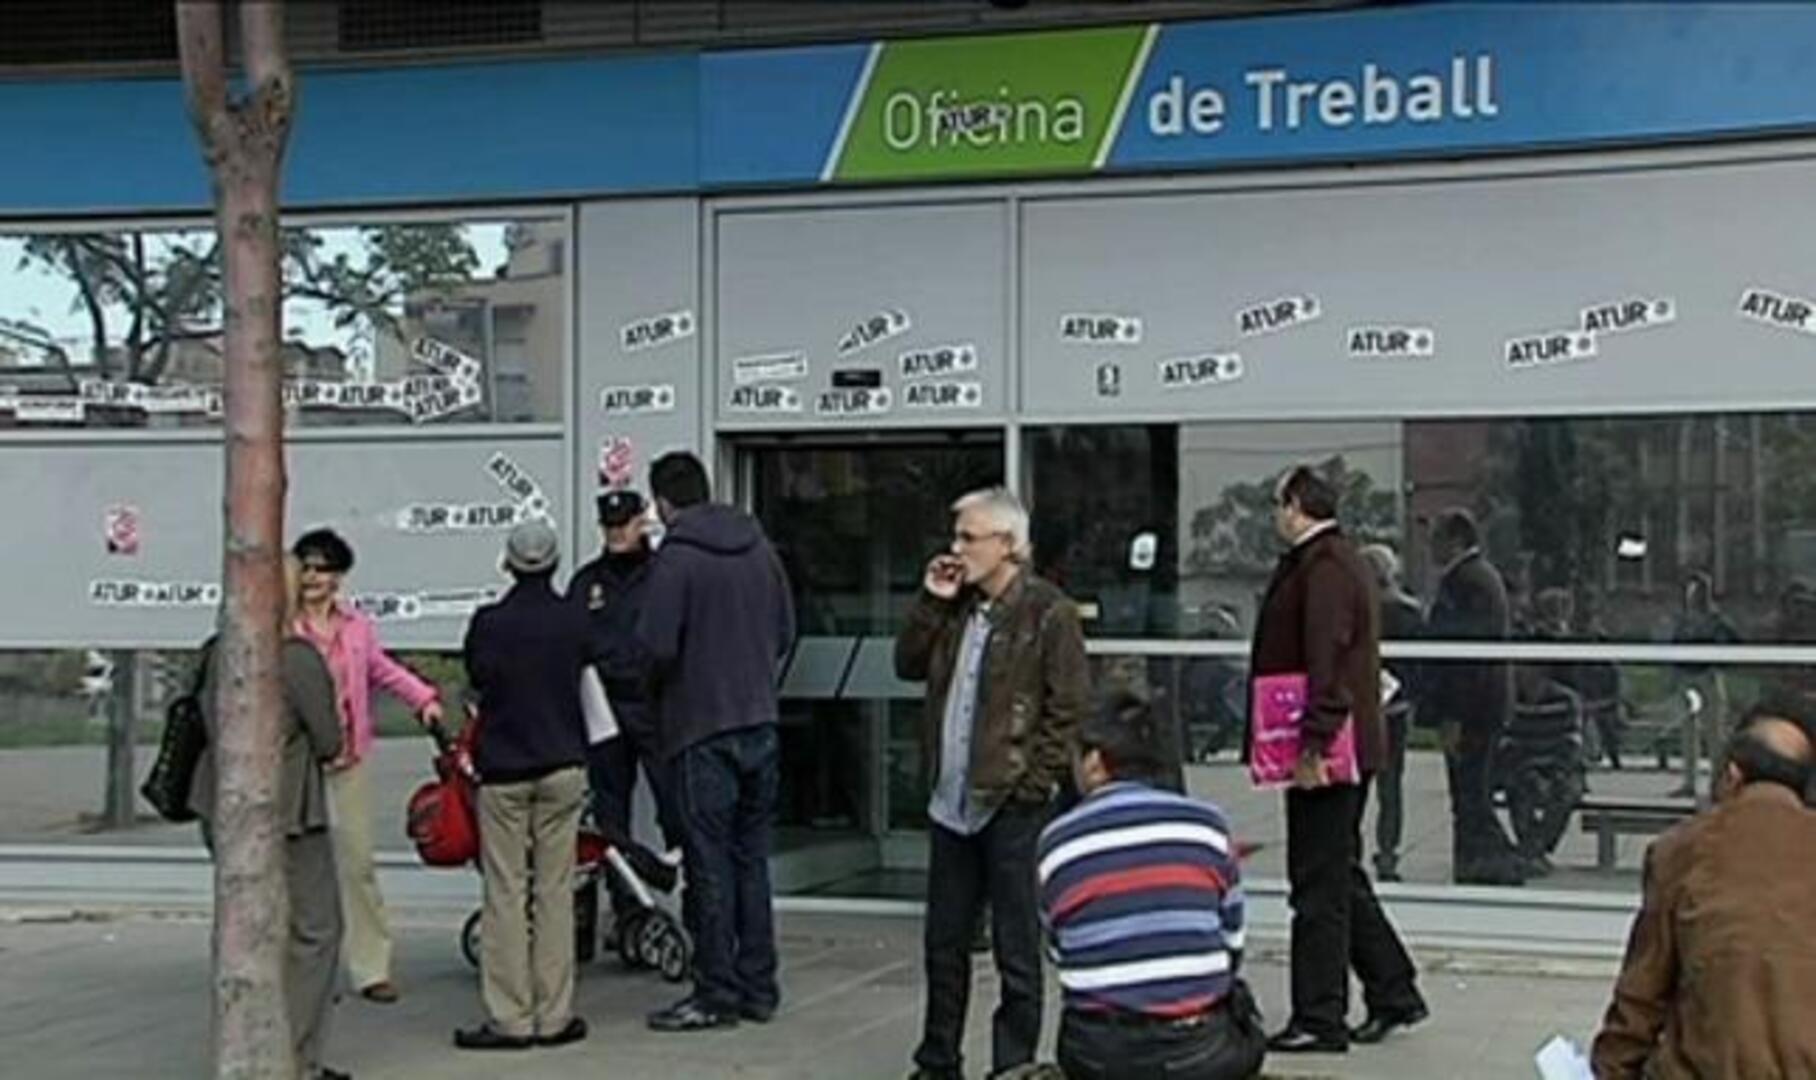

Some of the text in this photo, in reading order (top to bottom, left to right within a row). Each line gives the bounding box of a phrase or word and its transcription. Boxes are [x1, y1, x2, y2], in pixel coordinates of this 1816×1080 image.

[1149, 75, 1225, 135] de
[1245, 55, 1499, 130] Treball
[1239, 301, 1297, 332] ATUR
[1584, 301, 1649, 332] ATUR
[1740, 291, 1814, 328] ATUR
[625, 317, 673, 346] ATUR
[1062, 317, 1120, 340] ATUR
[1349, 329, 1410, 354] ATUR
[903, 349, 955, 376] ATUR
[1506, 334, 1570, 365] ATUR
[1163, 357, 1220, 384] ATUR
[338, 384, 386, 404] ATUR
[605, 388, 654, 410] ATUR
[730, 386, 784, 408] ATUR
[818, 389, 872, 413] ATUR
[907, 384, 961, 405] ATUR
[490, 457, 535, 497] ATUR
[93, 582, 140, 602] ATUR
